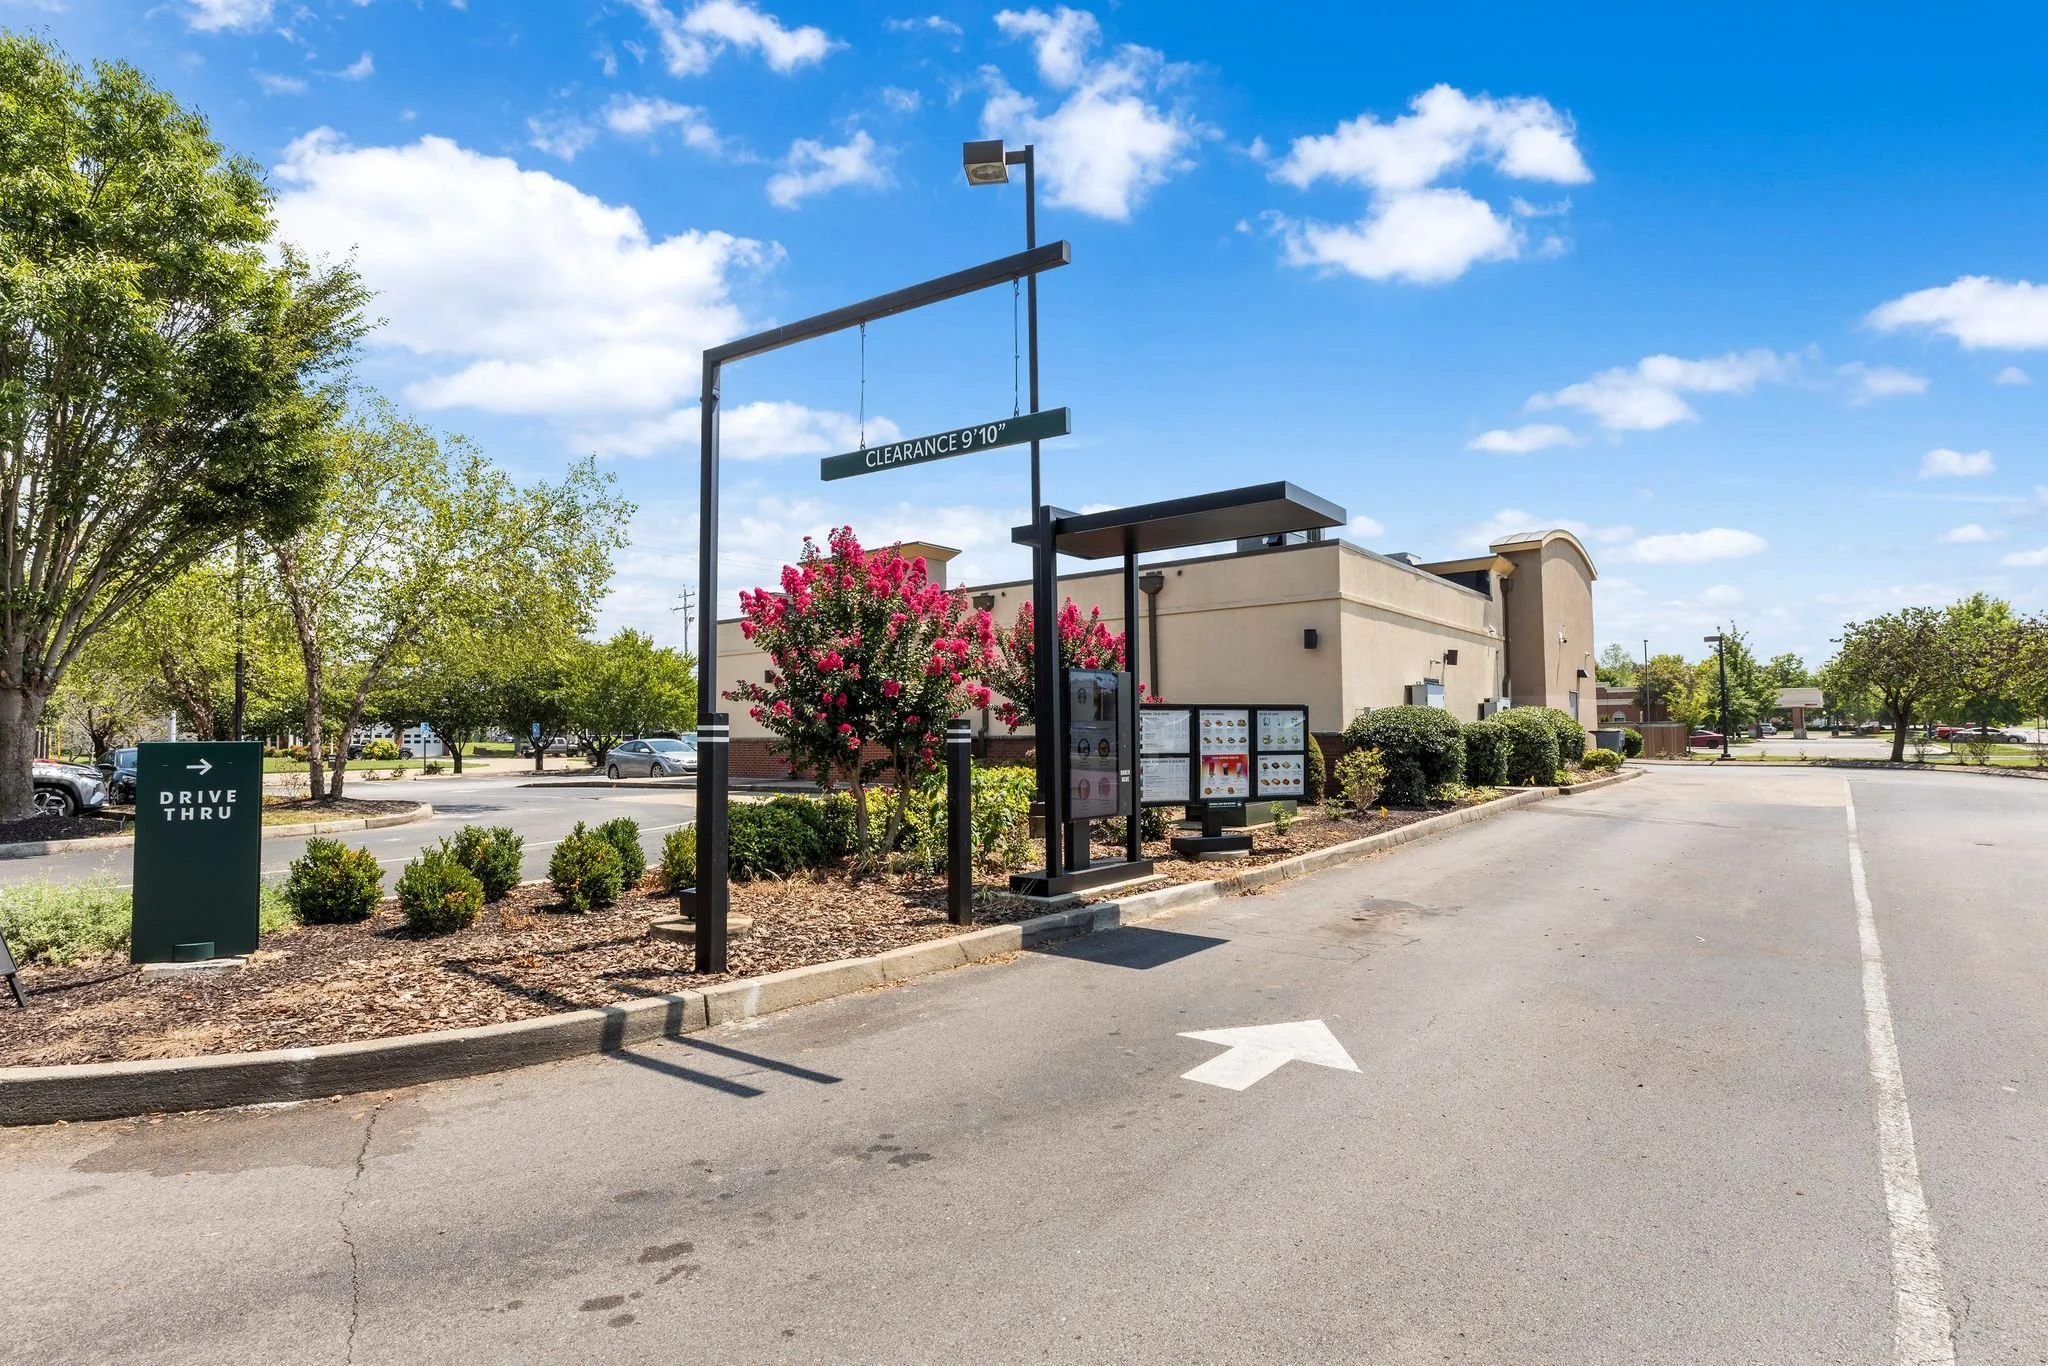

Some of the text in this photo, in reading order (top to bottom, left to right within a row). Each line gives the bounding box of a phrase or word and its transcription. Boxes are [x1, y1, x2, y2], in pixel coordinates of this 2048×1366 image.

[865, 433, 957, 468] CLEARANCE
[160, 789, 237, 805] DRIVE
[163, 806, 231, 821] THRU
